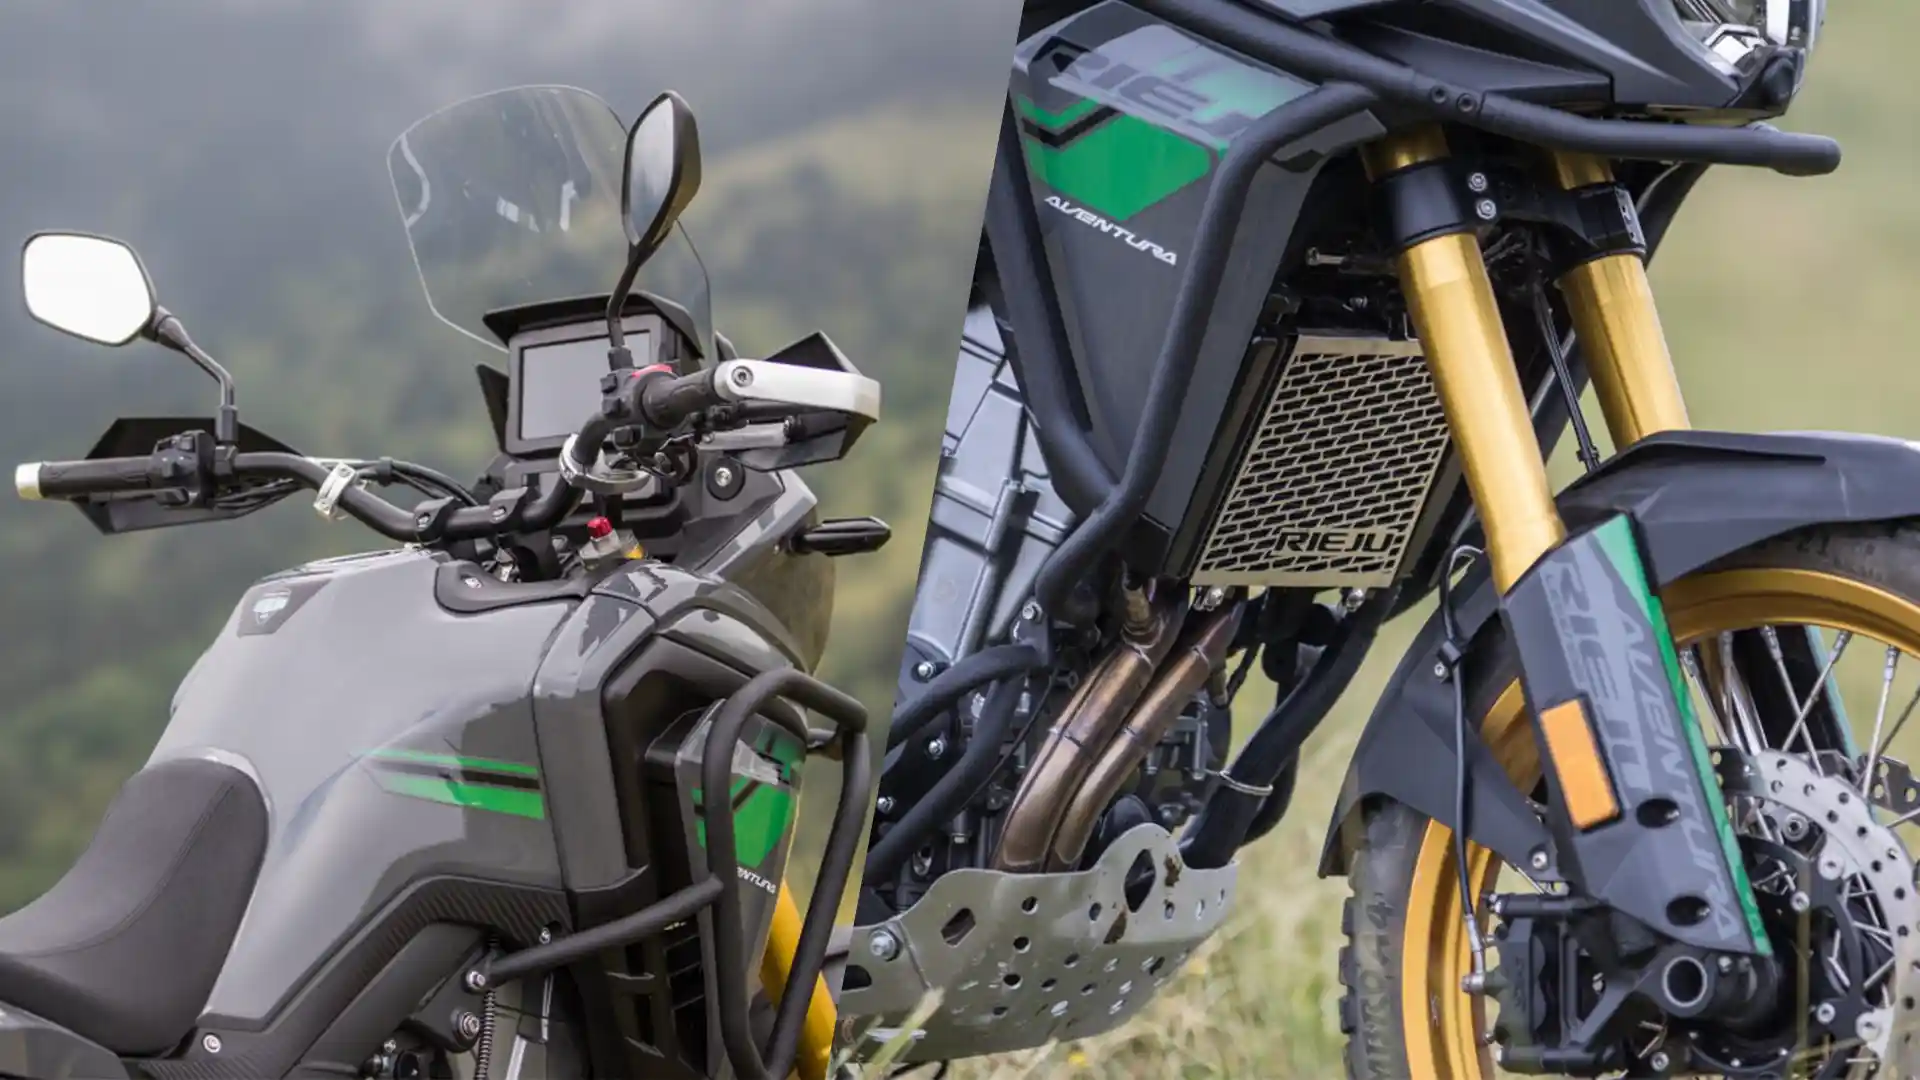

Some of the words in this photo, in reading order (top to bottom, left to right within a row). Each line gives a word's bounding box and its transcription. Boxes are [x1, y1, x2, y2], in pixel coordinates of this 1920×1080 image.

[1044, 195, 1177, 265] AVENTURA
[1275, 531, 1394, 552] RIEJU
[1618, 607, 1740, 940] AVENTURA
